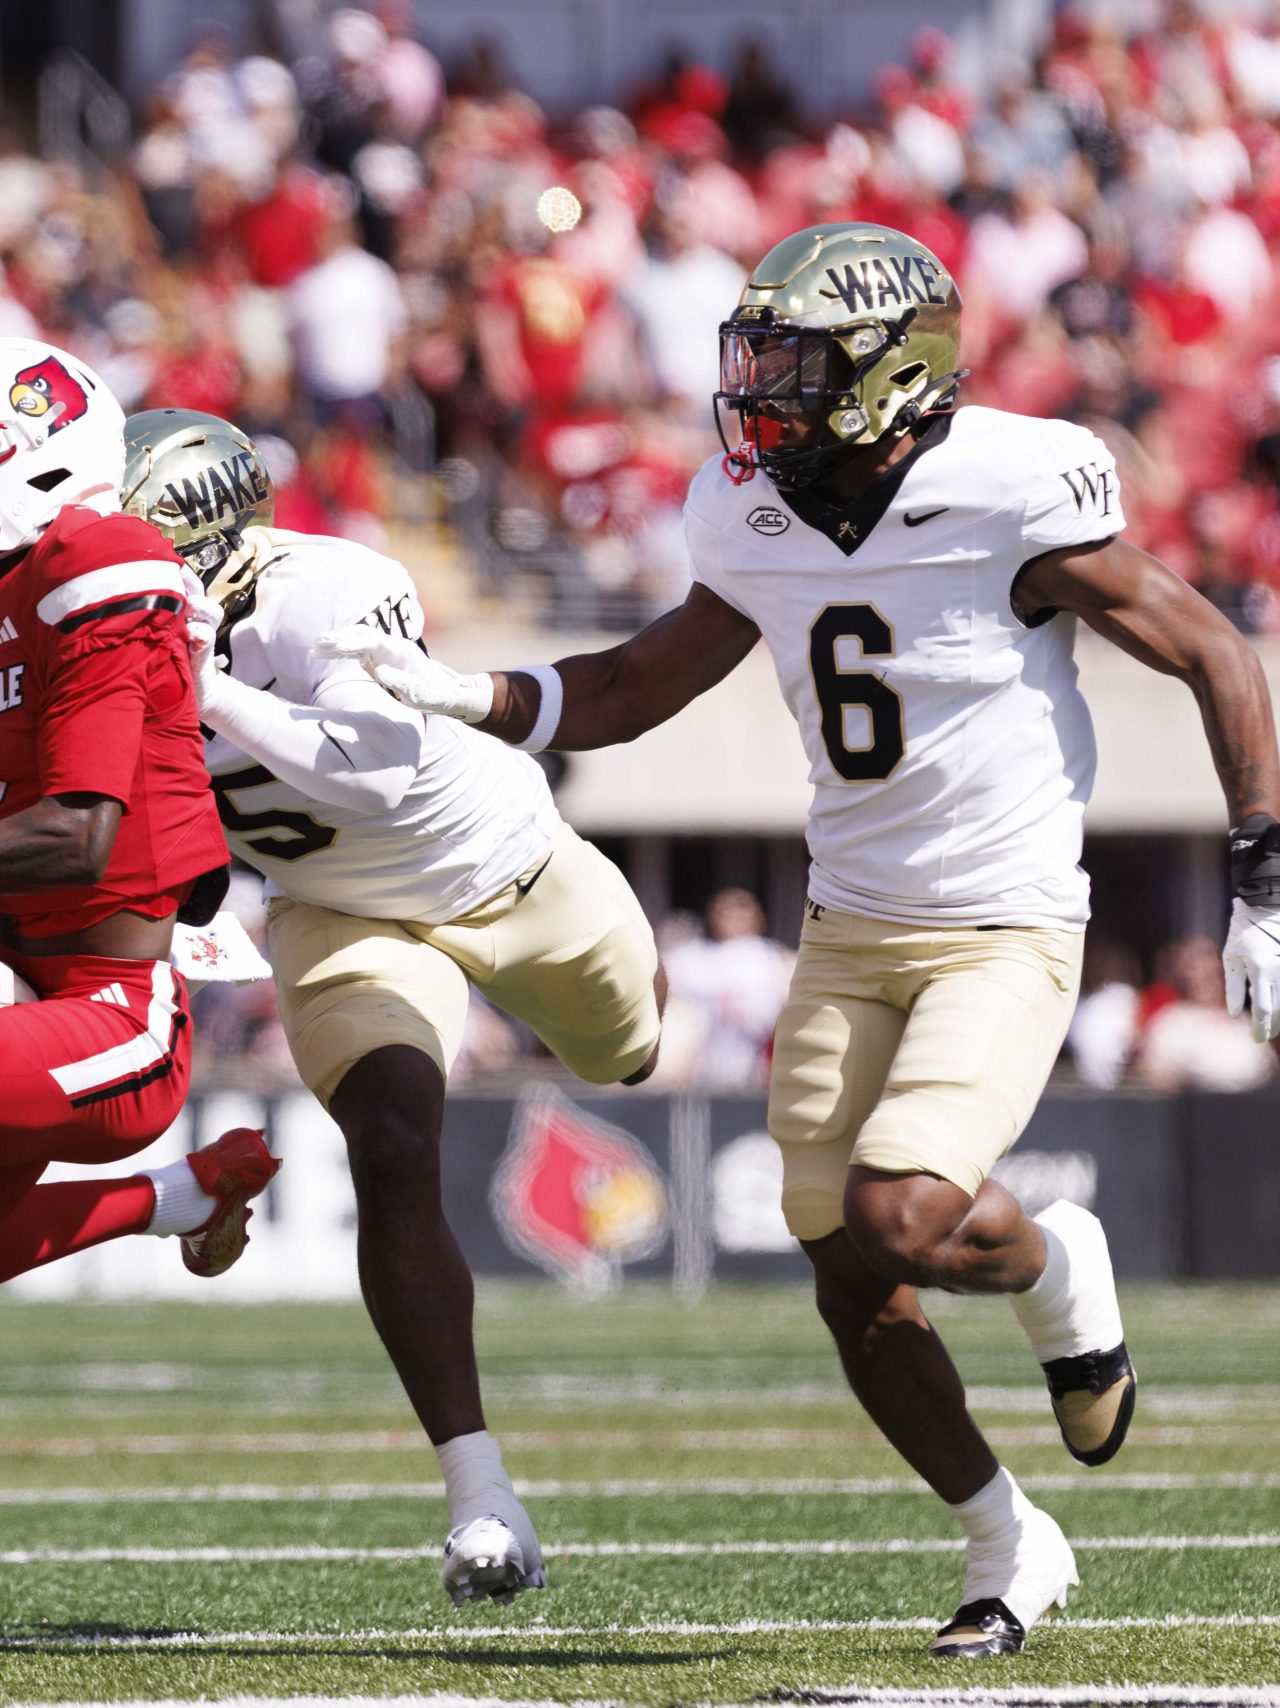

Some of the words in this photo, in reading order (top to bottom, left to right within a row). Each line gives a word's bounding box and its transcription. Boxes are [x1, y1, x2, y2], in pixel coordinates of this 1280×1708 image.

[825, 256, 947, 314] WAKE
[164, 451, 268, 529] WAKE
[1058, 461, 1114, 517] WF
[808, 601, 907, 785] 6
[209, 762, 341, 864] 5
